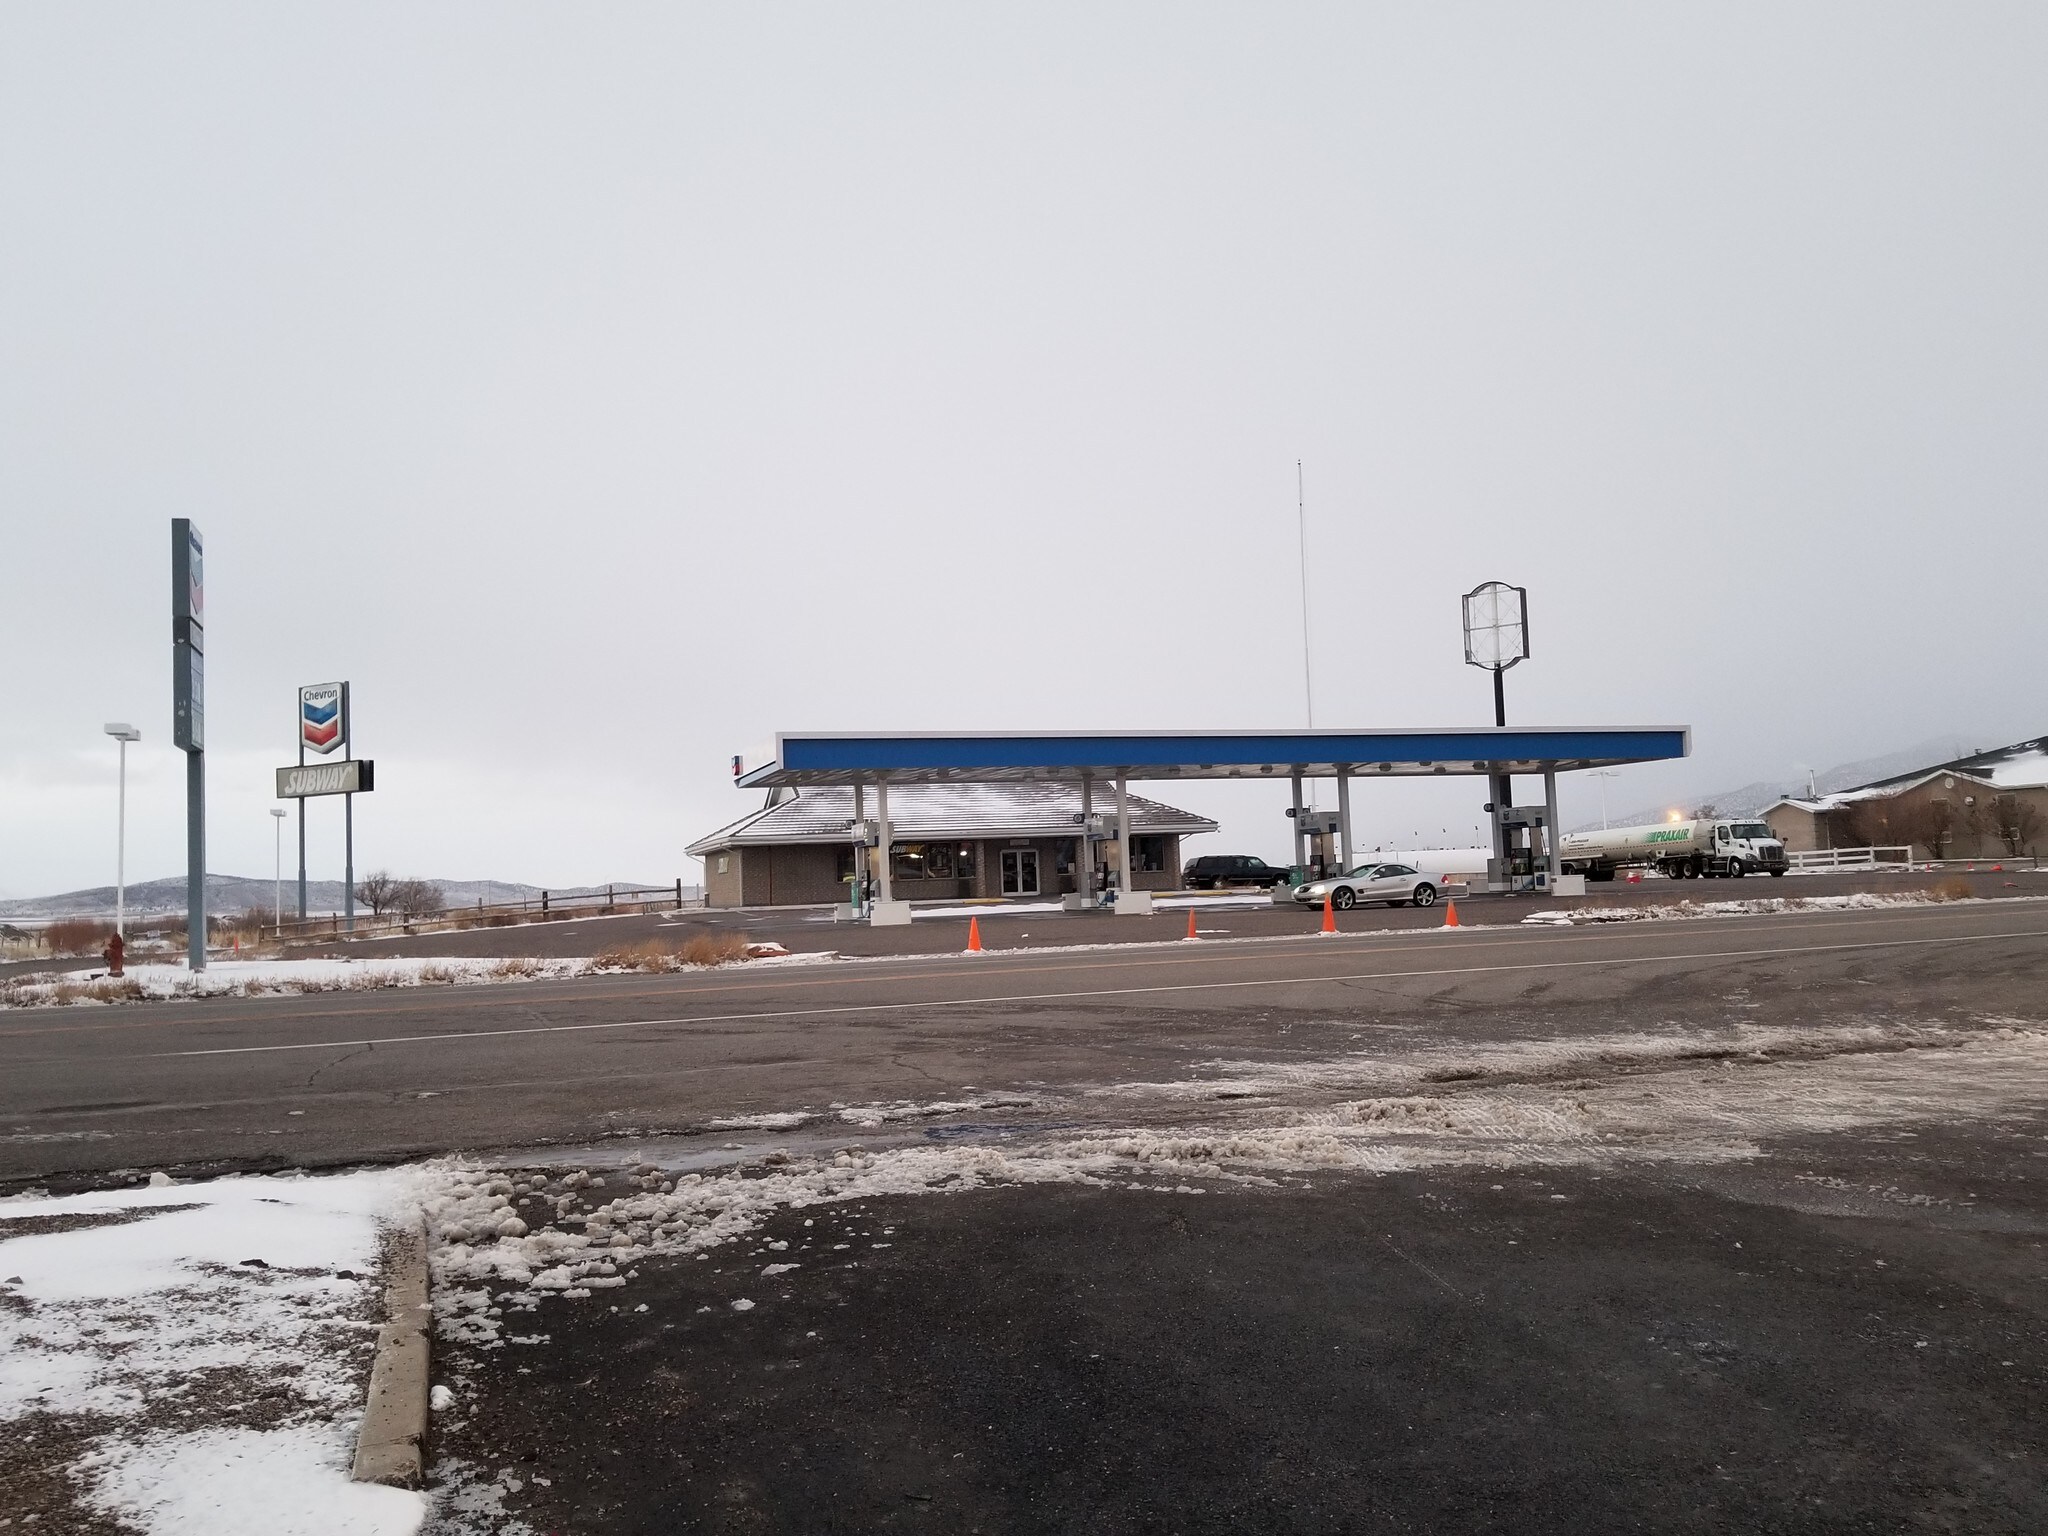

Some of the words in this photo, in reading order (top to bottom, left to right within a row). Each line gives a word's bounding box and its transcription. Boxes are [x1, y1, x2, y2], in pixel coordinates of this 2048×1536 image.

[303, 689, 338, 701] Chevron
[284, 764, 354, 795] SUBWAY
[1655, 828, 1690, 843] PRAXAIR
[890, 844, 925, 854] SUBWAY
